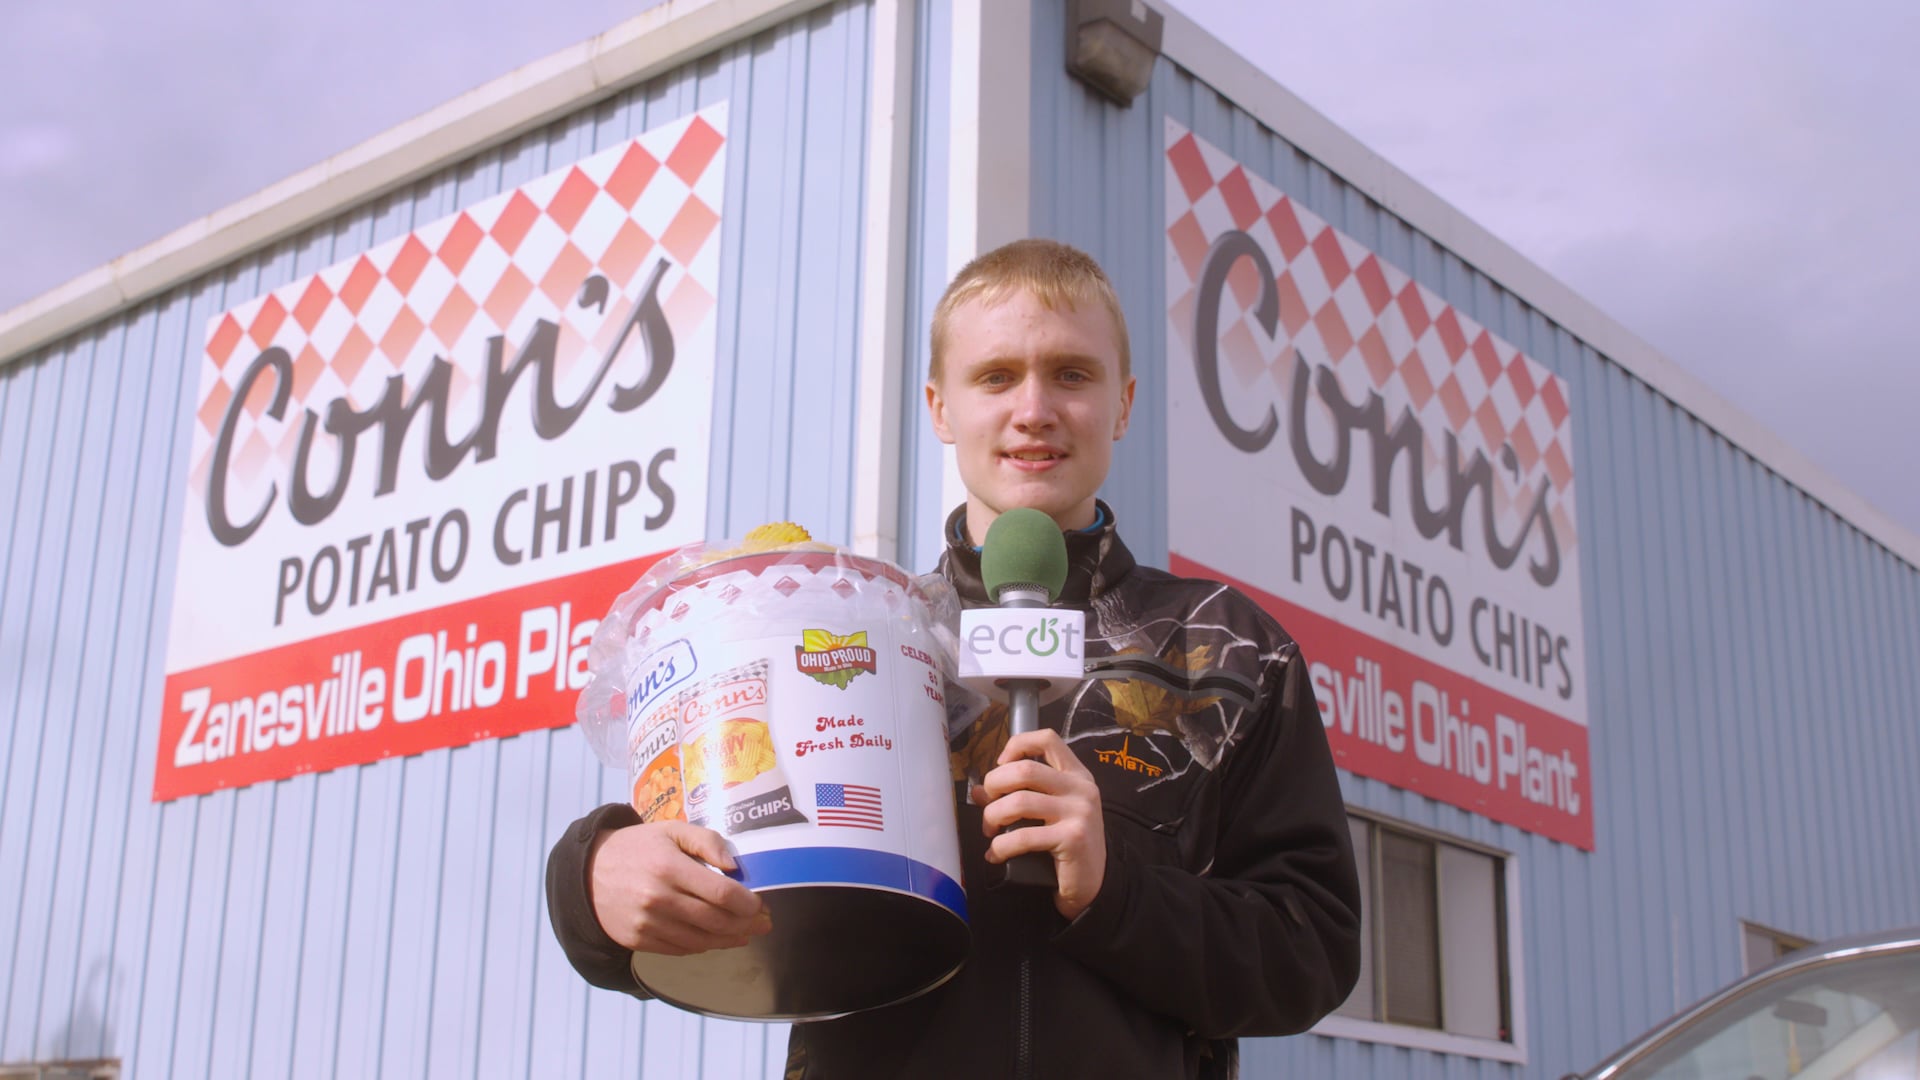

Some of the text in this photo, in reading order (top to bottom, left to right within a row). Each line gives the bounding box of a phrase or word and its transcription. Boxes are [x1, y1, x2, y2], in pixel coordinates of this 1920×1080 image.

[205, 257, 675, 547] Conn's
[1192, 229, 1561, 588] Conn's
[273, 447, 676, 627] POTATO CHIPS
[967, 617, 1080, 660] ecot
[1290, 506, 1572, 700] POTATO CHIPS
[174, 601, 601, 768] Zanesville Ohio Pla
[801, 647, 871, 668] OHIO PROUD
[795, 732, 892, 757] Fresh Daily
[815, 714, 864, 732] Made
[1098, 752, 1161, 778] HABIT
[1308, 656, 1580, 816] sville Ohio Plant
[749, 796, 791, 820] CHIPS
